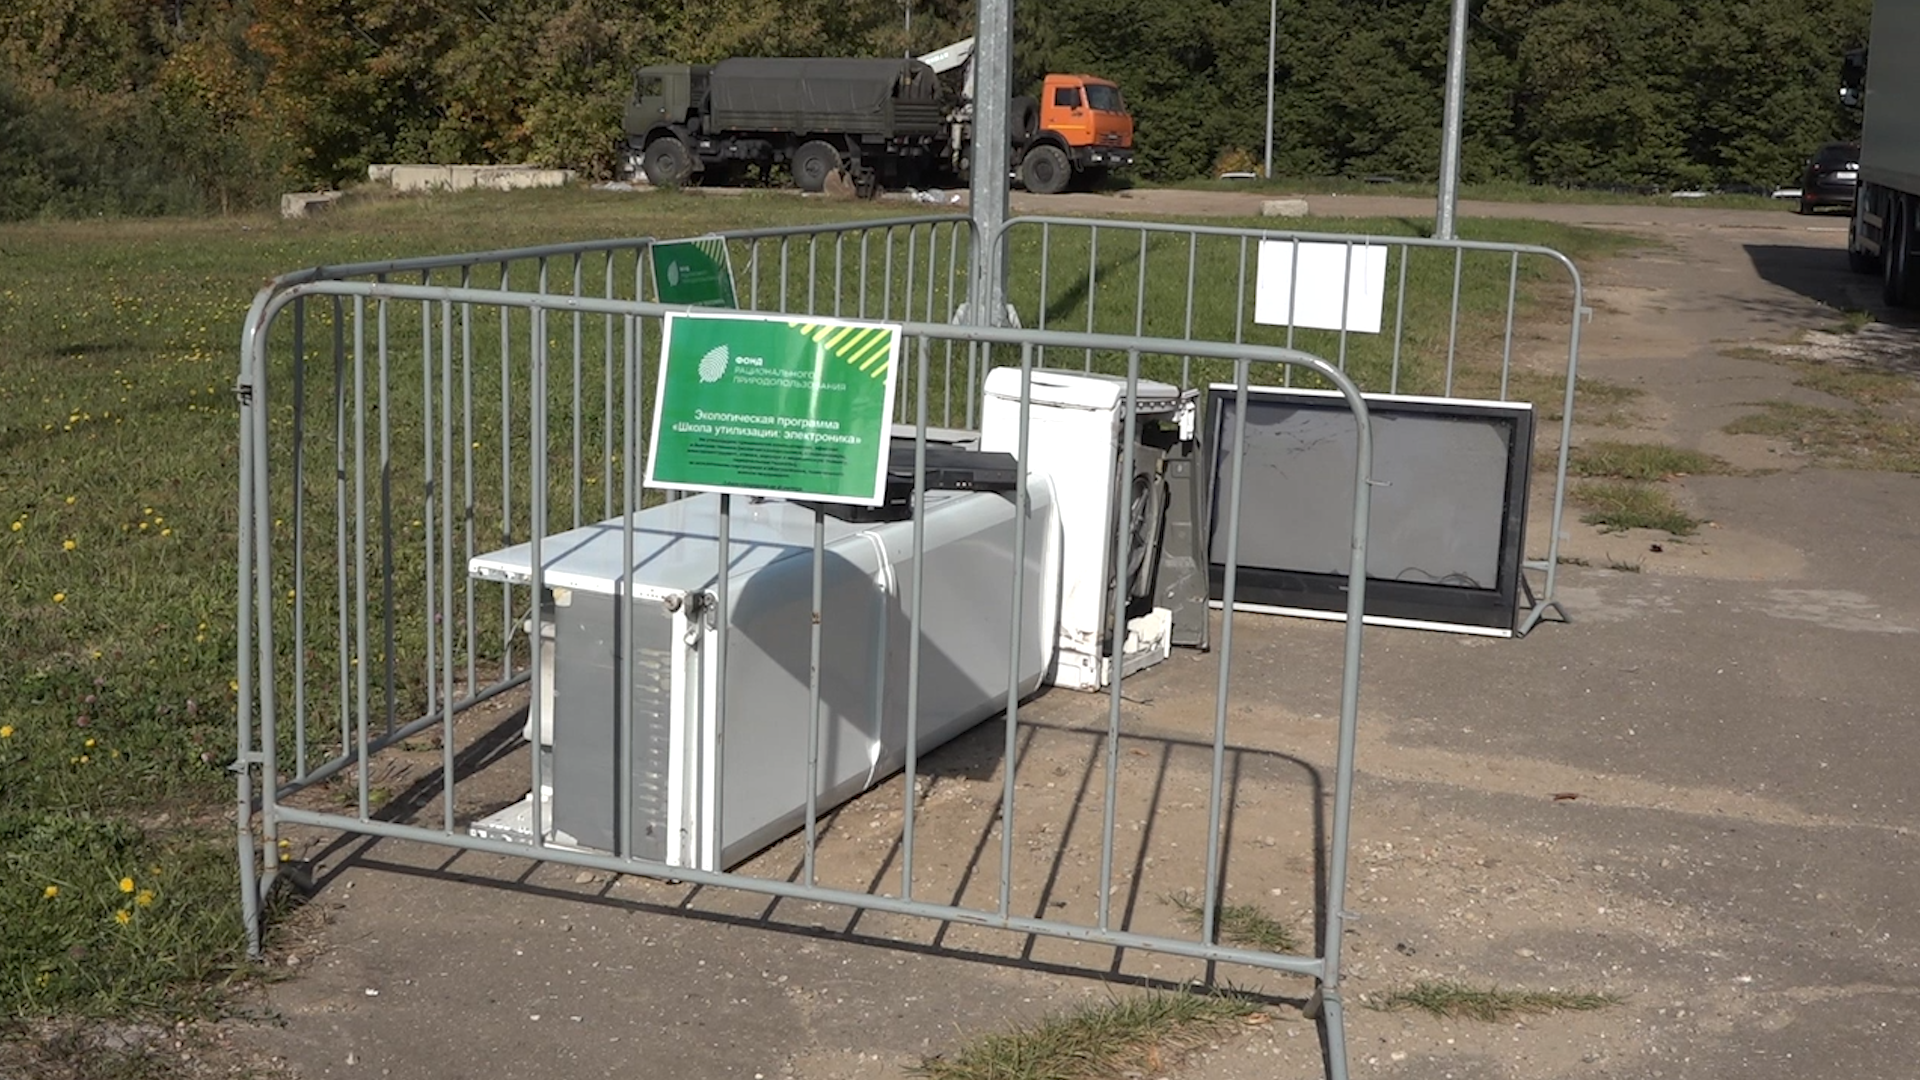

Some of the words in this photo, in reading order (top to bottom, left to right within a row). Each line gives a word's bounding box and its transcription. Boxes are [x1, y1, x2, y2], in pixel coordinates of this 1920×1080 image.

[735, 356, 763, 366] ФОНД
[734, 366, 817, 378] РАЦИОНАЛЬНОГО
[733, 376, 846, 390] ПРИРОДОПОЛЬЗОАНИЯ
[694, 409, 774, 425] Экологическая
[777, 416, 840, 430] программа
[672, 421, 712, 433] «Школа
[714, 424, 781, 439] утилизации:
[783, 431, 862, 445] электроника»
